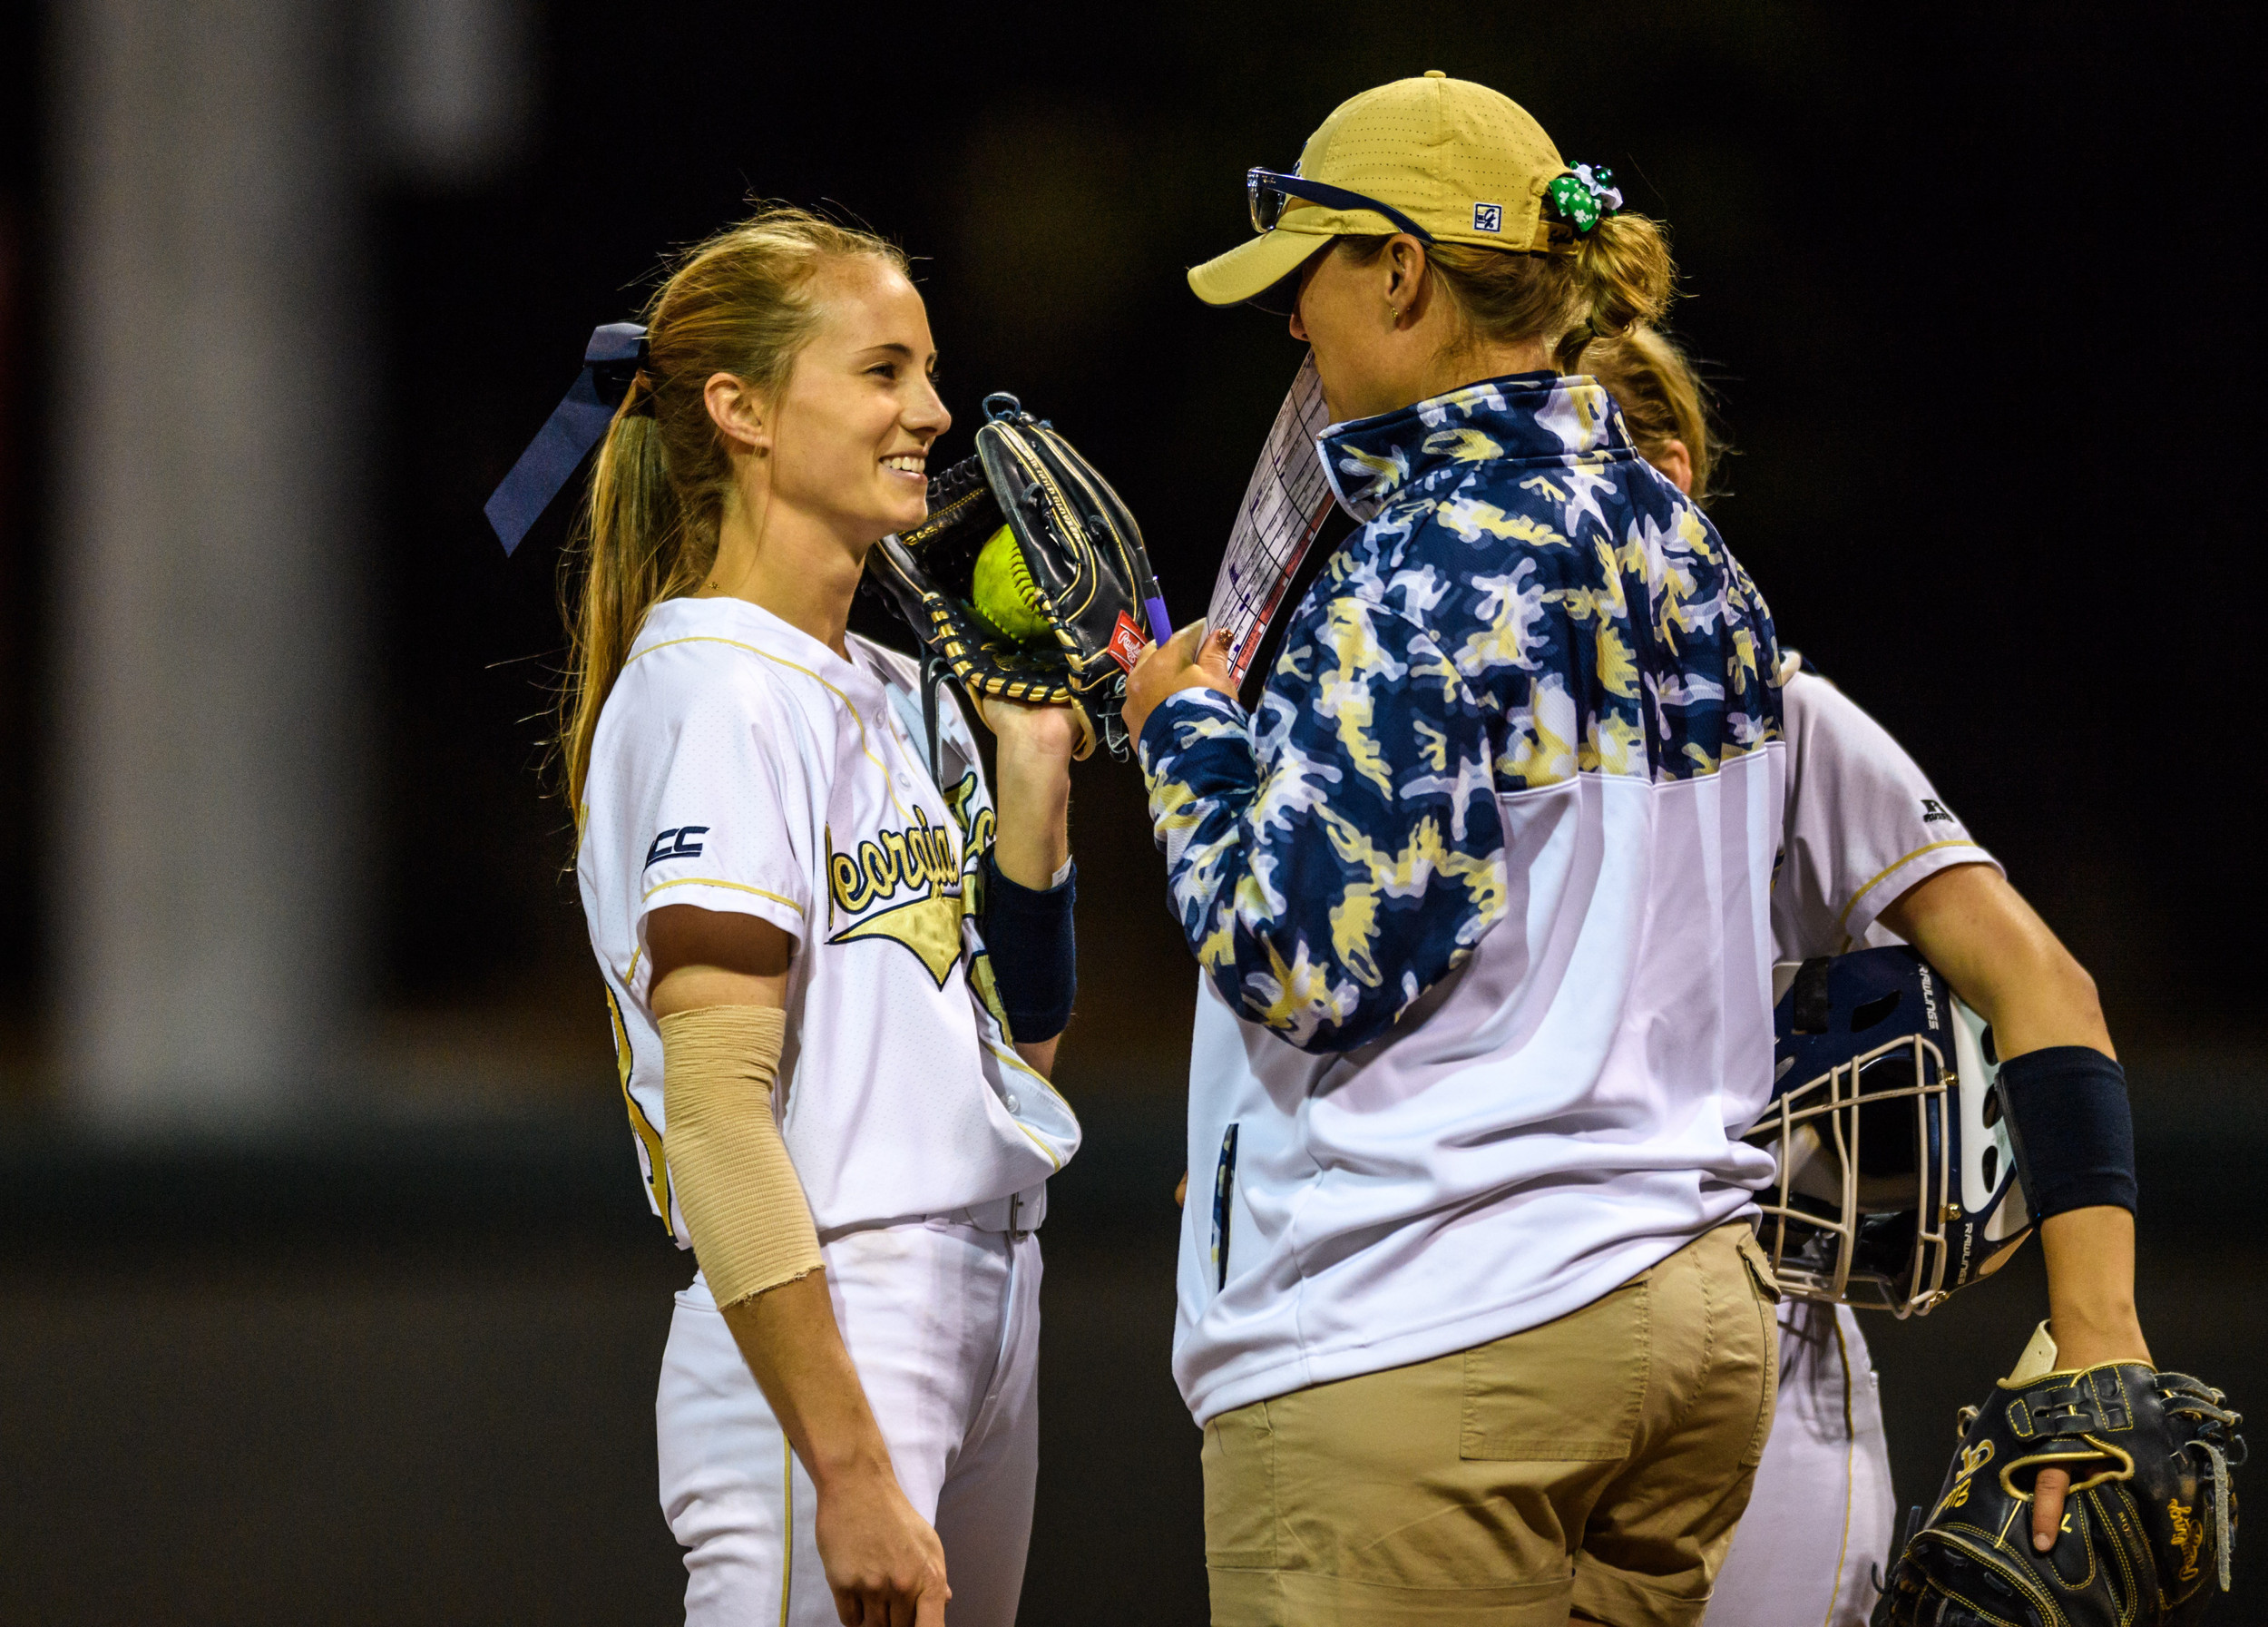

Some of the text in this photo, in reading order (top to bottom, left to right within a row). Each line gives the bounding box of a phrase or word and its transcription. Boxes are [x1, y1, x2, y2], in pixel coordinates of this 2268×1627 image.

[645, 826, 710, 868] CC
[824, 804, 960, 929] eorgia
[1918, 963, 1940, 1031] RAWLINGS
[1957, 1221, 1973, 1286] RAWLINGS
